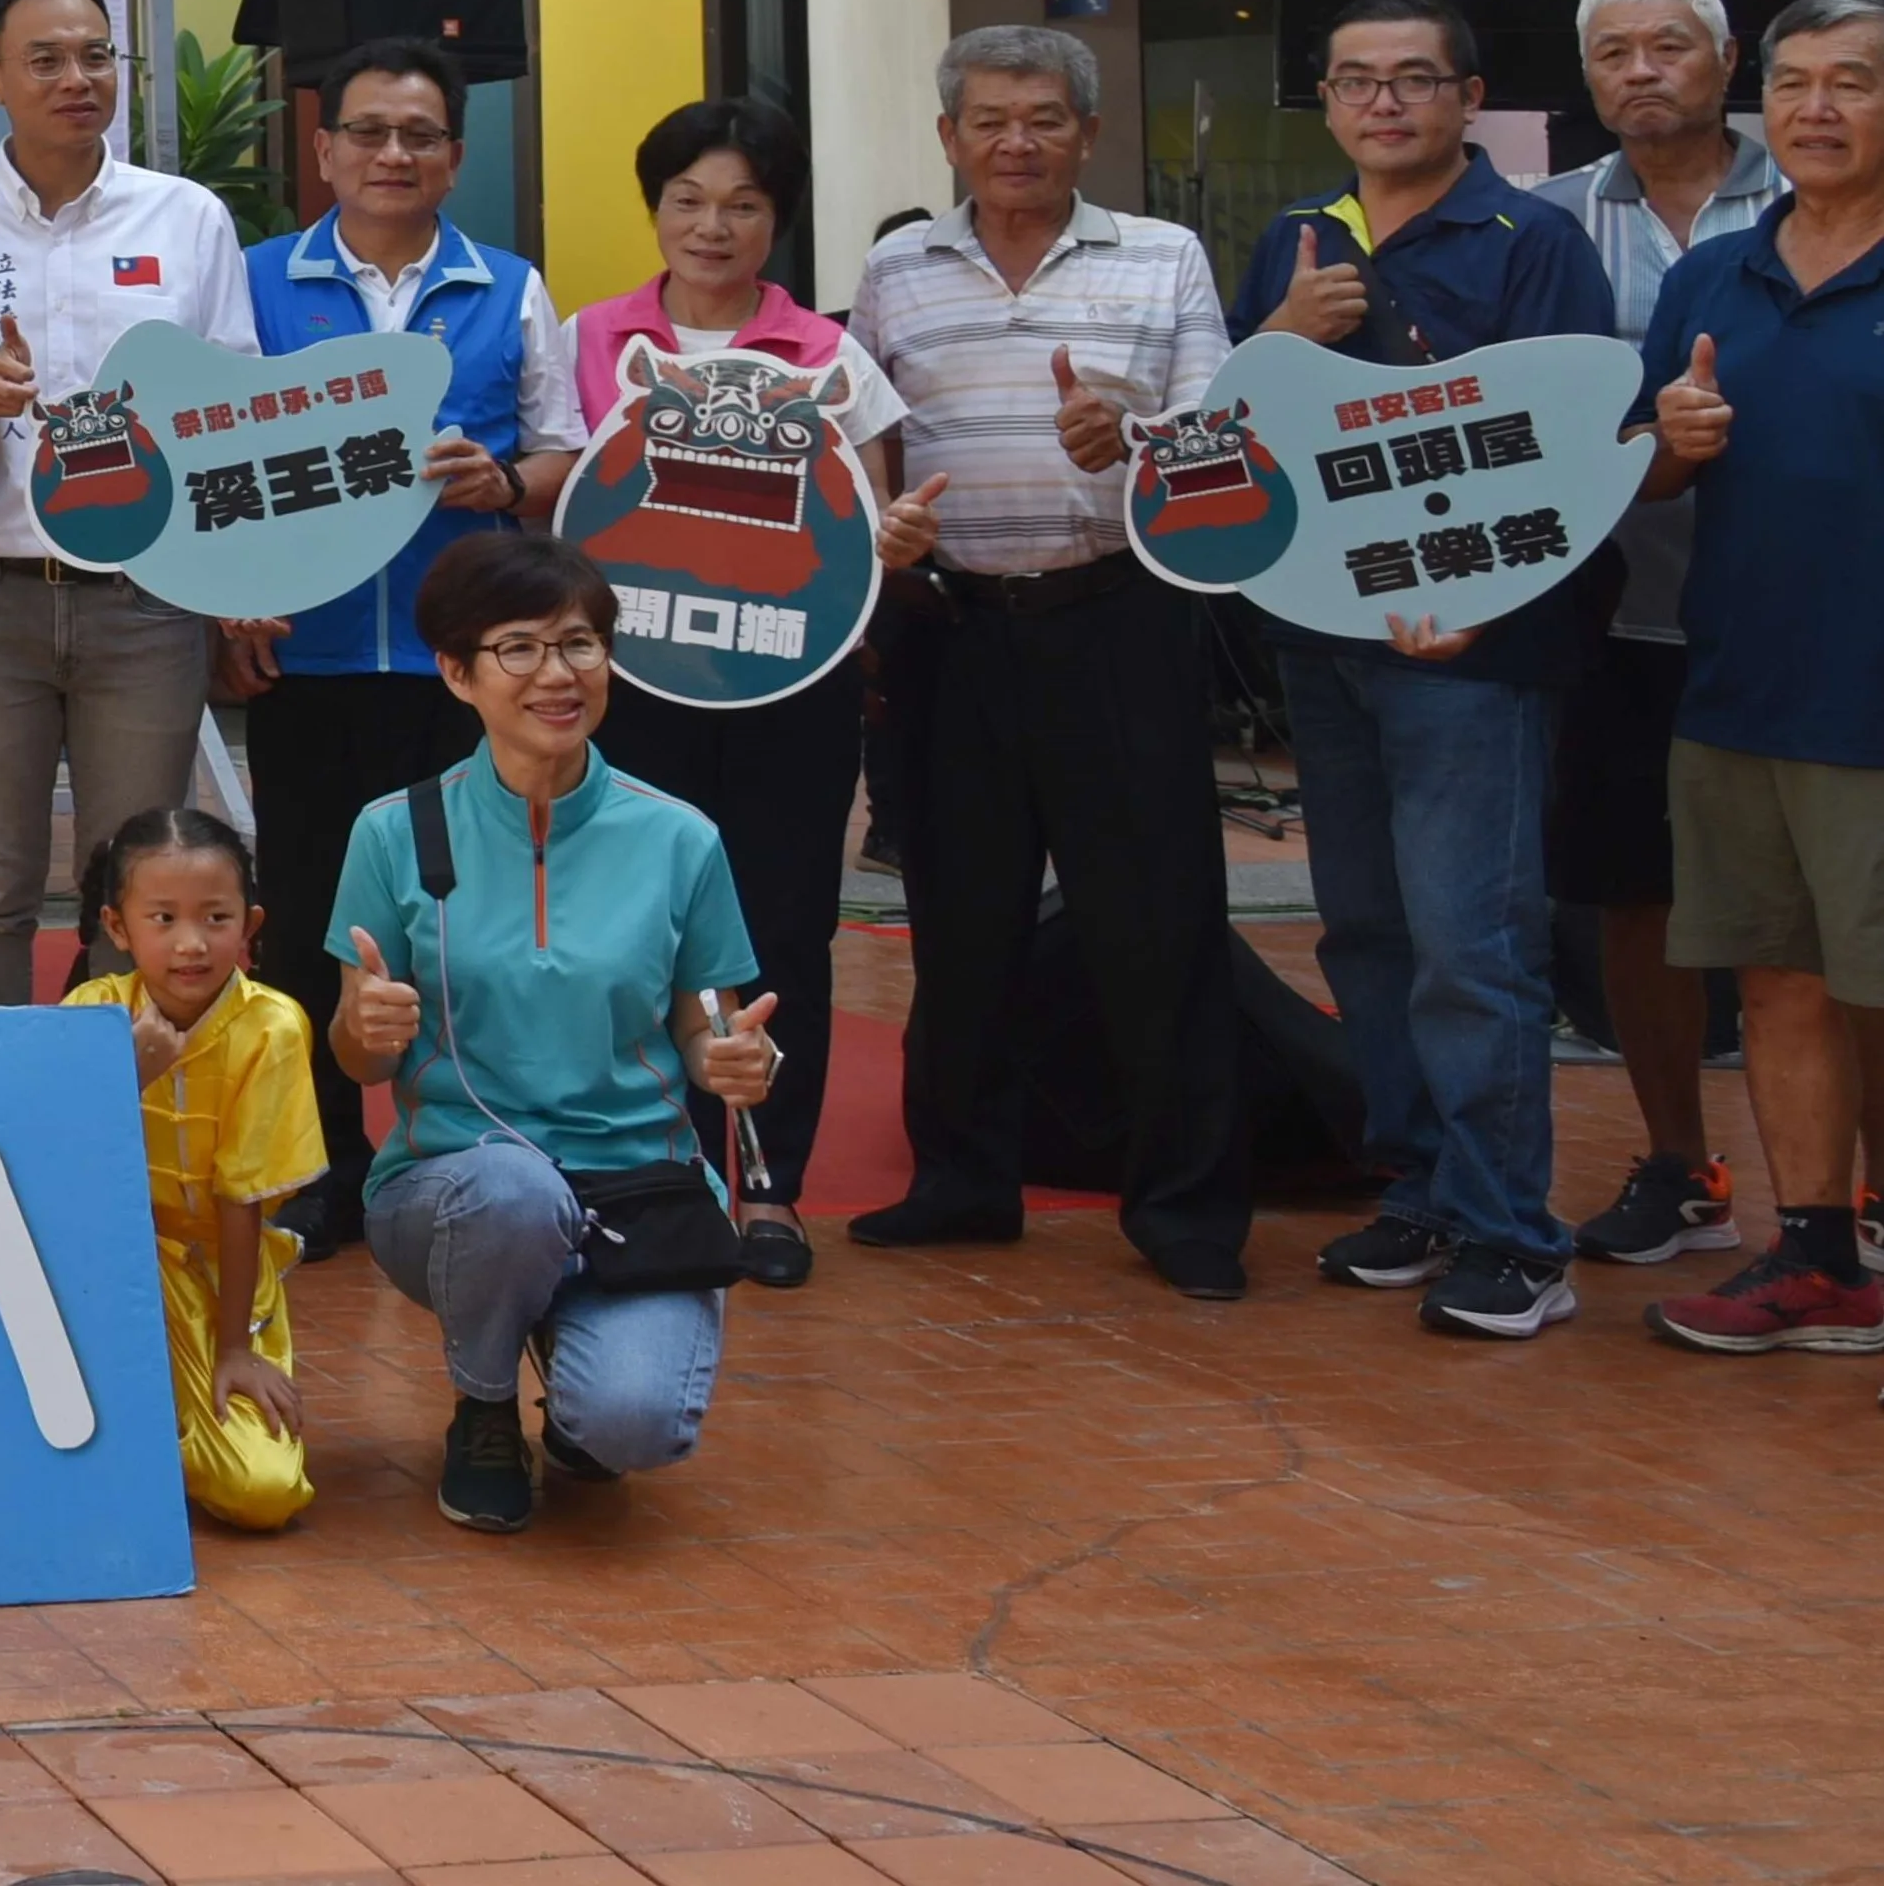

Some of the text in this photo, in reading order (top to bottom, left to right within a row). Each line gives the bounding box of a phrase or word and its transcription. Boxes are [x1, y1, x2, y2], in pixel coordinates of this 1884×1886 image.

[1334, 376, 1484, 432] 詔安客庄
[184, 428, 416, 533] 溪王祭
[1315, 410, 1543, 503] 回頭屋
[1344, 507, 1571, 598] 音樂祭
[614, 584, 808, 660] 開口獅
